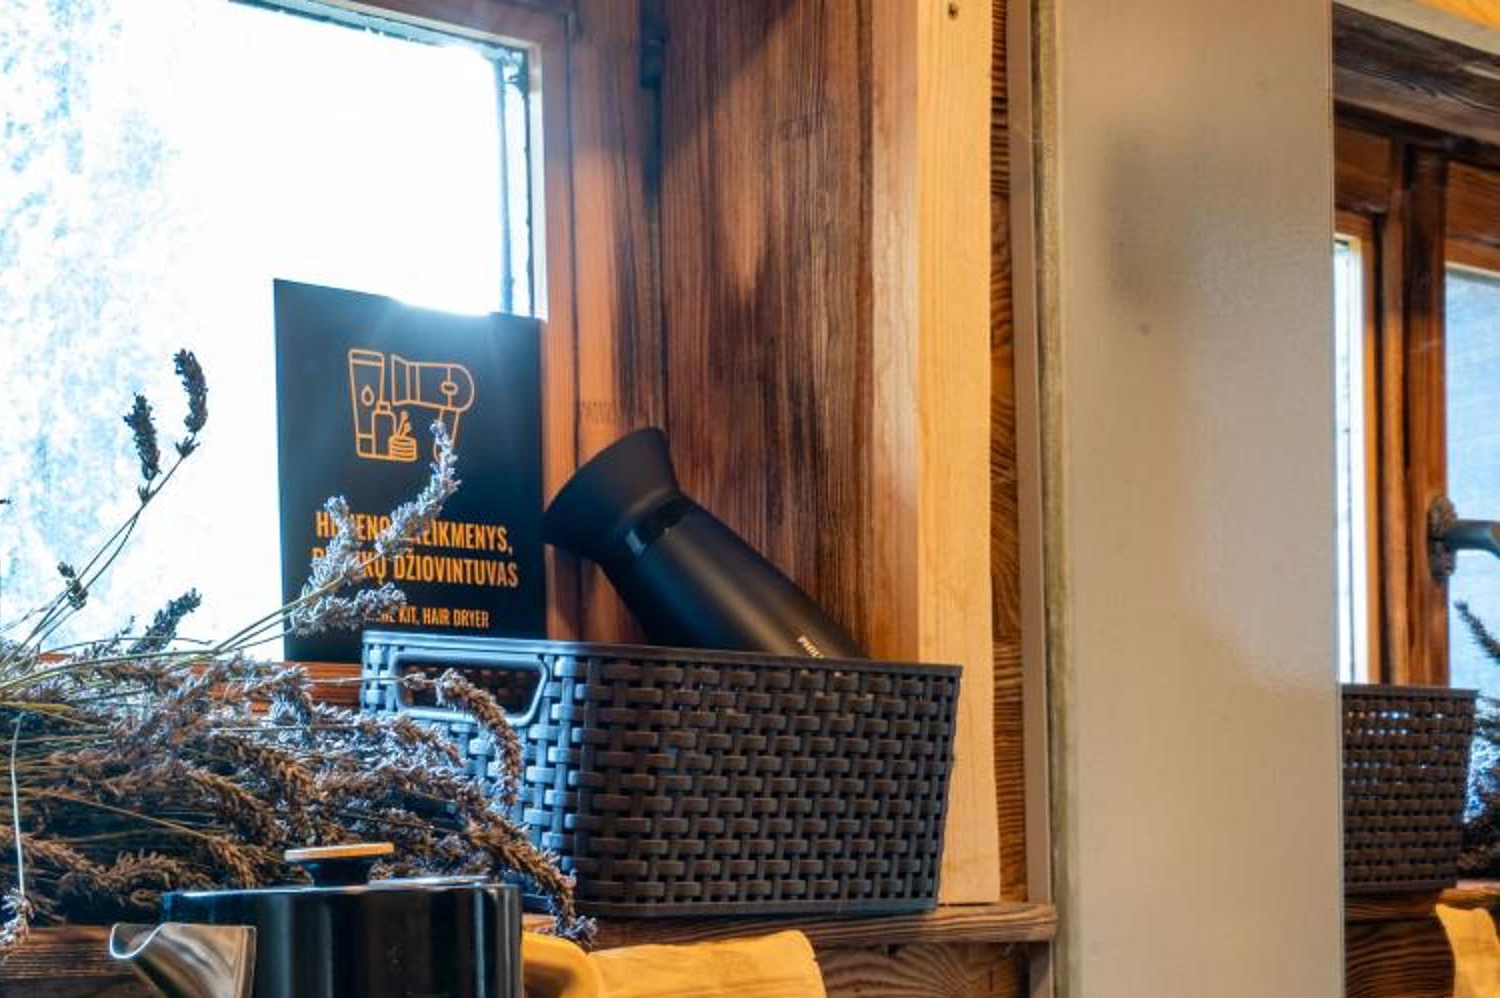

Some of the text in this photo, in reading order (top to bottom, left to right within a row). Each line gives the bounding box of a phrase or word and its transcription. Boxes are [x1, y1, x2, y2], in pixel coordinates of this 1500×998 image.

[393, 545, 519, 588] DŽIOVINTUVAS
[422, 607, 450, 625] HAIR
[453, 608, 489, 629] DRYER
